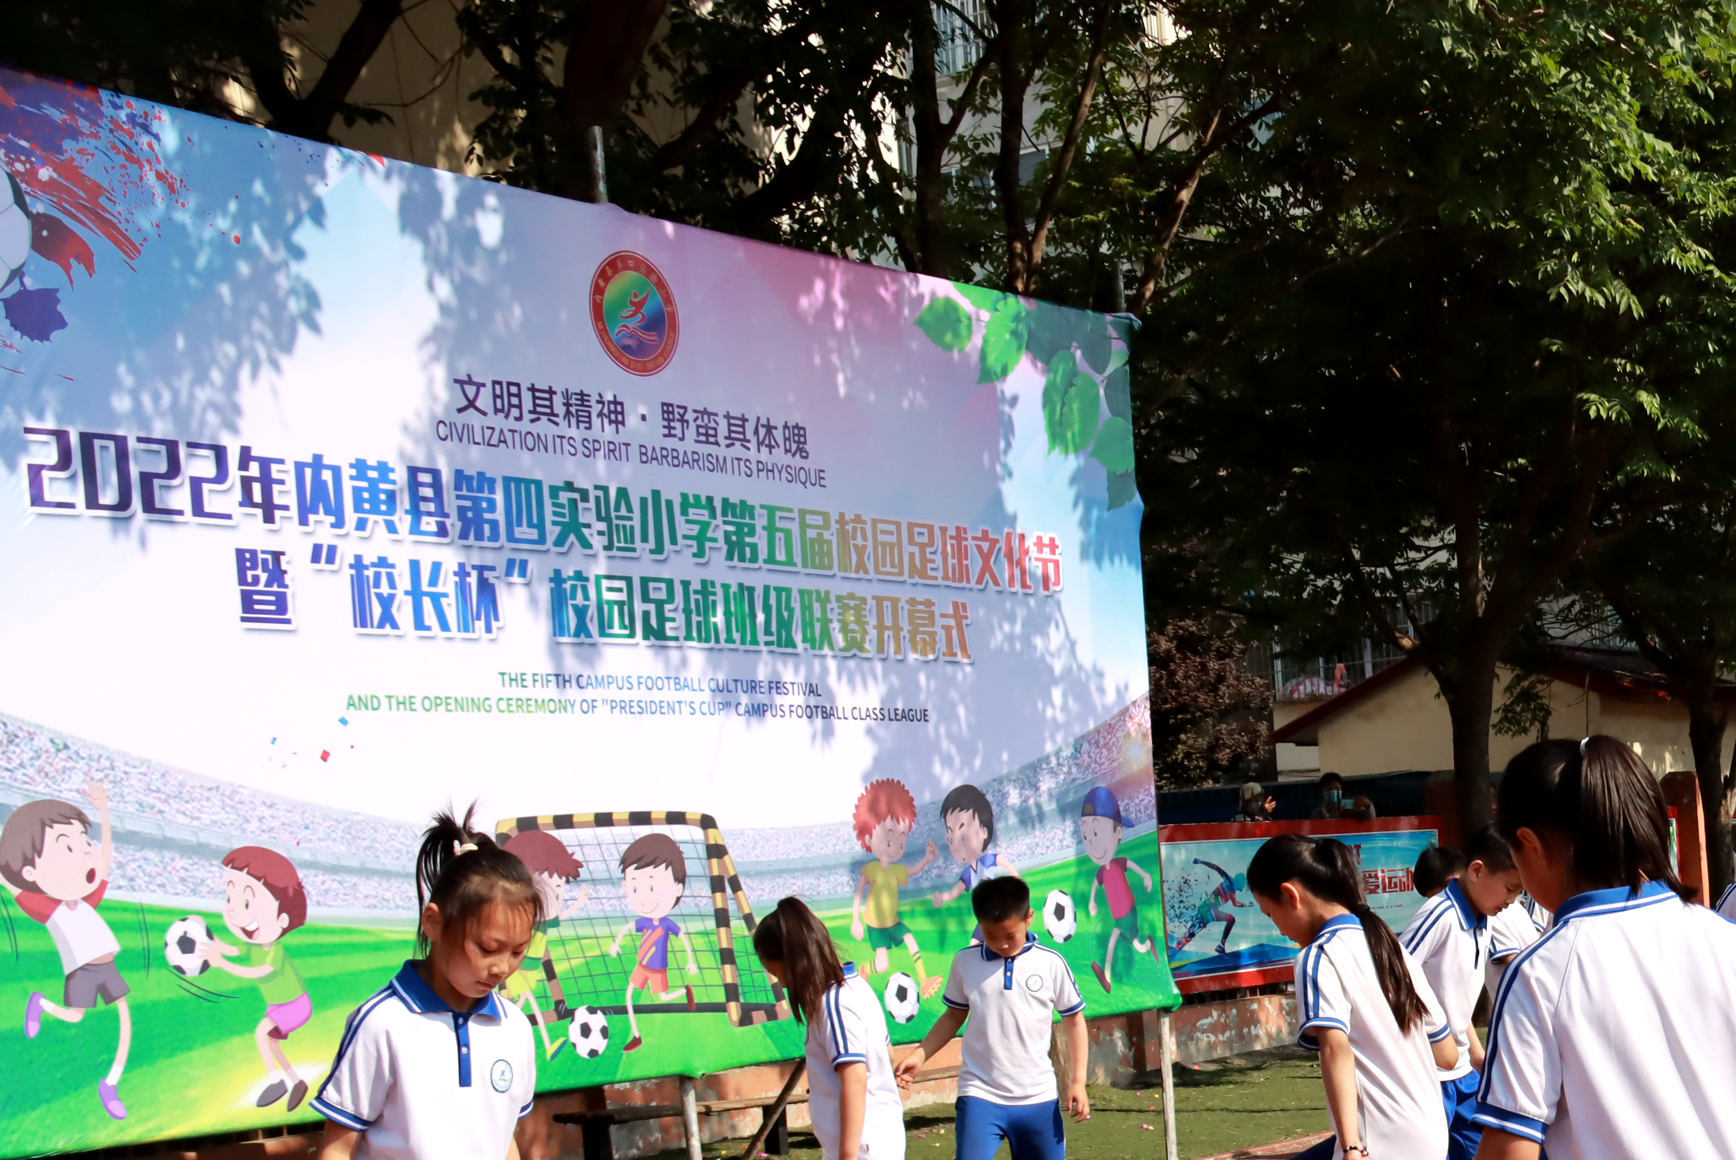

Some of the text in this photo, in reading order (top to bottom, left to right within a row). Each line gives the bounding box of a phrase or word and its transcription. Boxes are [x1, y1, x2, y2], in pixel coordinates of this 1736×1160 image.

[436, 419, 828, 490] CIVILIZATION ITS SPIRIT BARBARISM ITS PHYSIQUE
[23, 425, 1062, 592] 2022年内黄县第四实验小学第五届校园足球文化节
[346, 694, 381, 711] AND
[385, 695, 417, 712] THE
[421, 695, 492, 713] OPENING
[496, 697, 576, 714] CEREMONY
[580, 699, 598, 714] OF
[699, 701, 731, 717] CUP"
[735, 703, 786, 718] CAMPUS
[789, 704, 849, 721] FOOTBALL
[851, 706, 886, 722] CLASS
[888, 707, 929, 723] LEAGUE
[498, 672, 822, 697] THE FIFTH CAMPUS FOOTBALL CULTURE FESTIVAL
